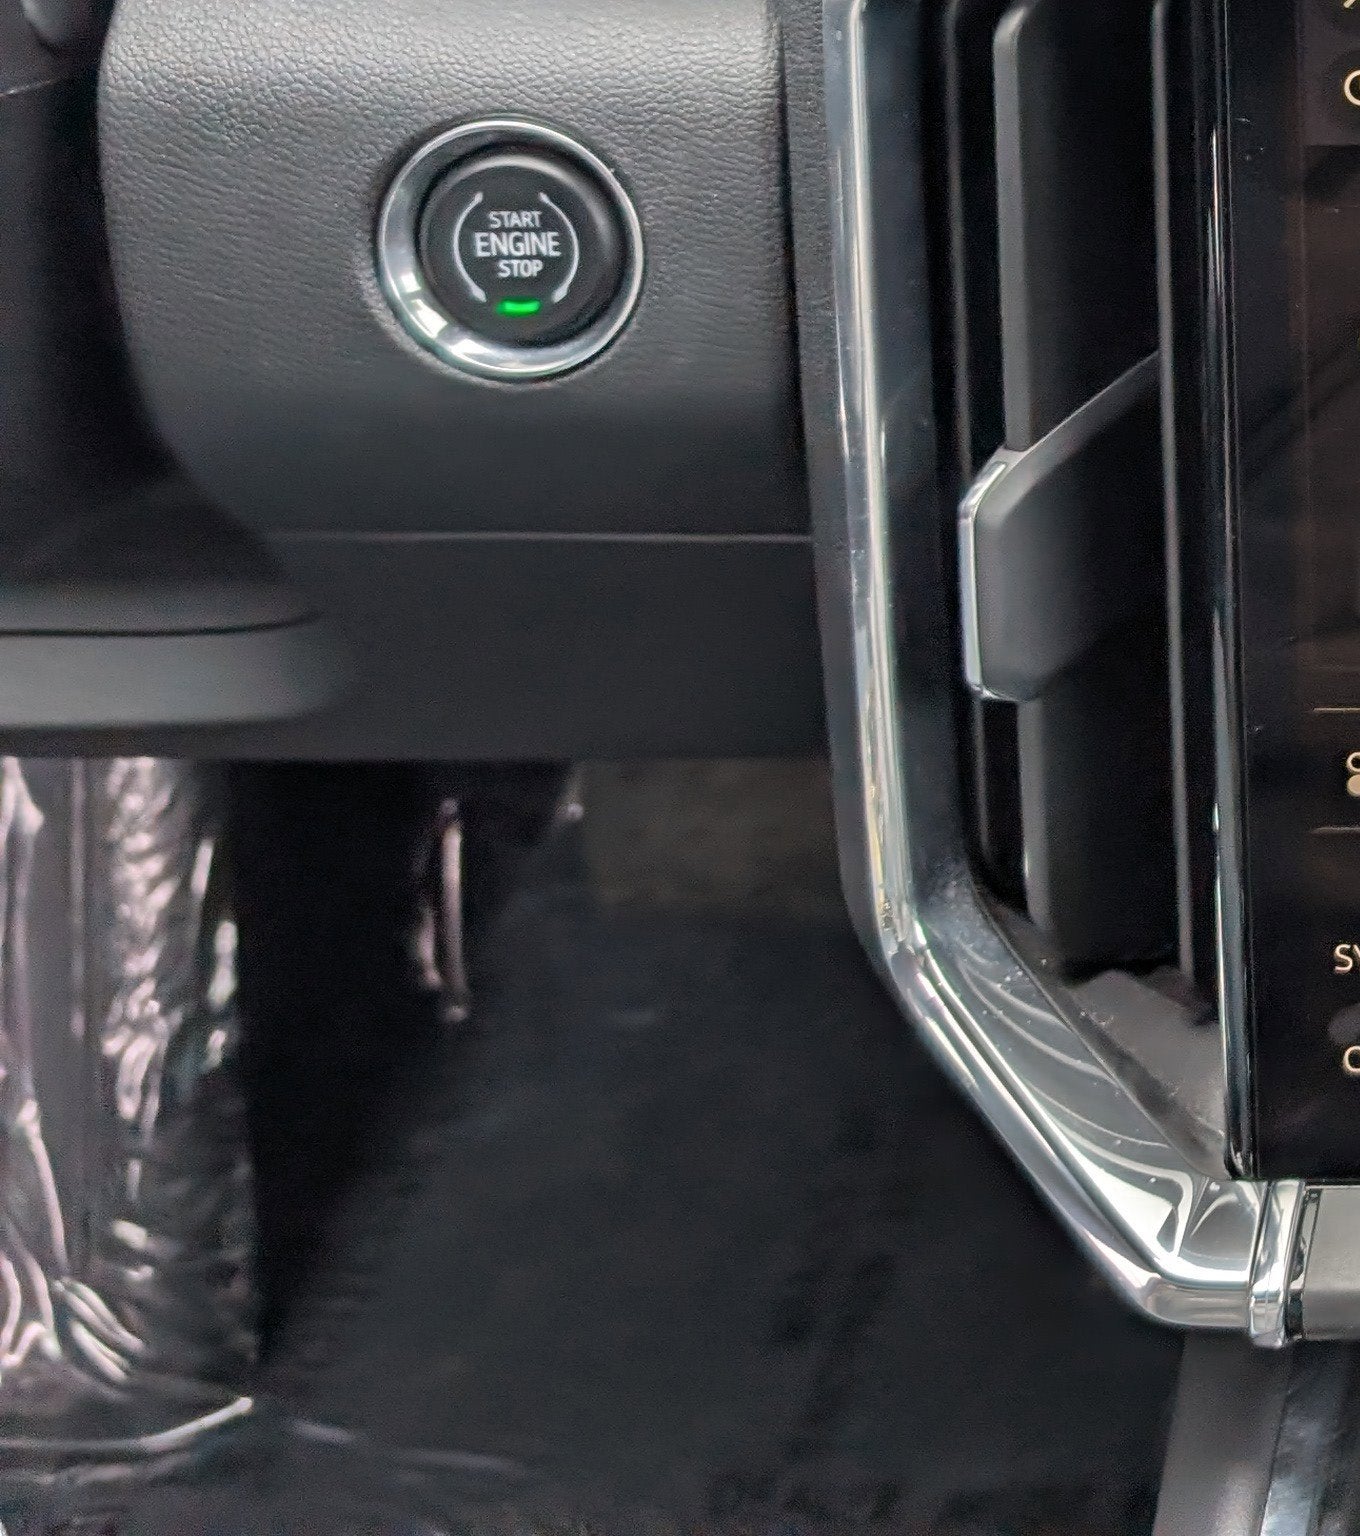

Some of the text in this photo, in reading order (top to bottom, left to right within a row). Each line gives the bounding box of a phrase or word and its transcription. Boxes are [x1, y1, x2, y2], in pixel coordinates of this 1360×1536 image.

[488, 210, 541, 229] START
[474, 231, 561, 257] ENGINE
[497, 258, 543, 278] STOP
